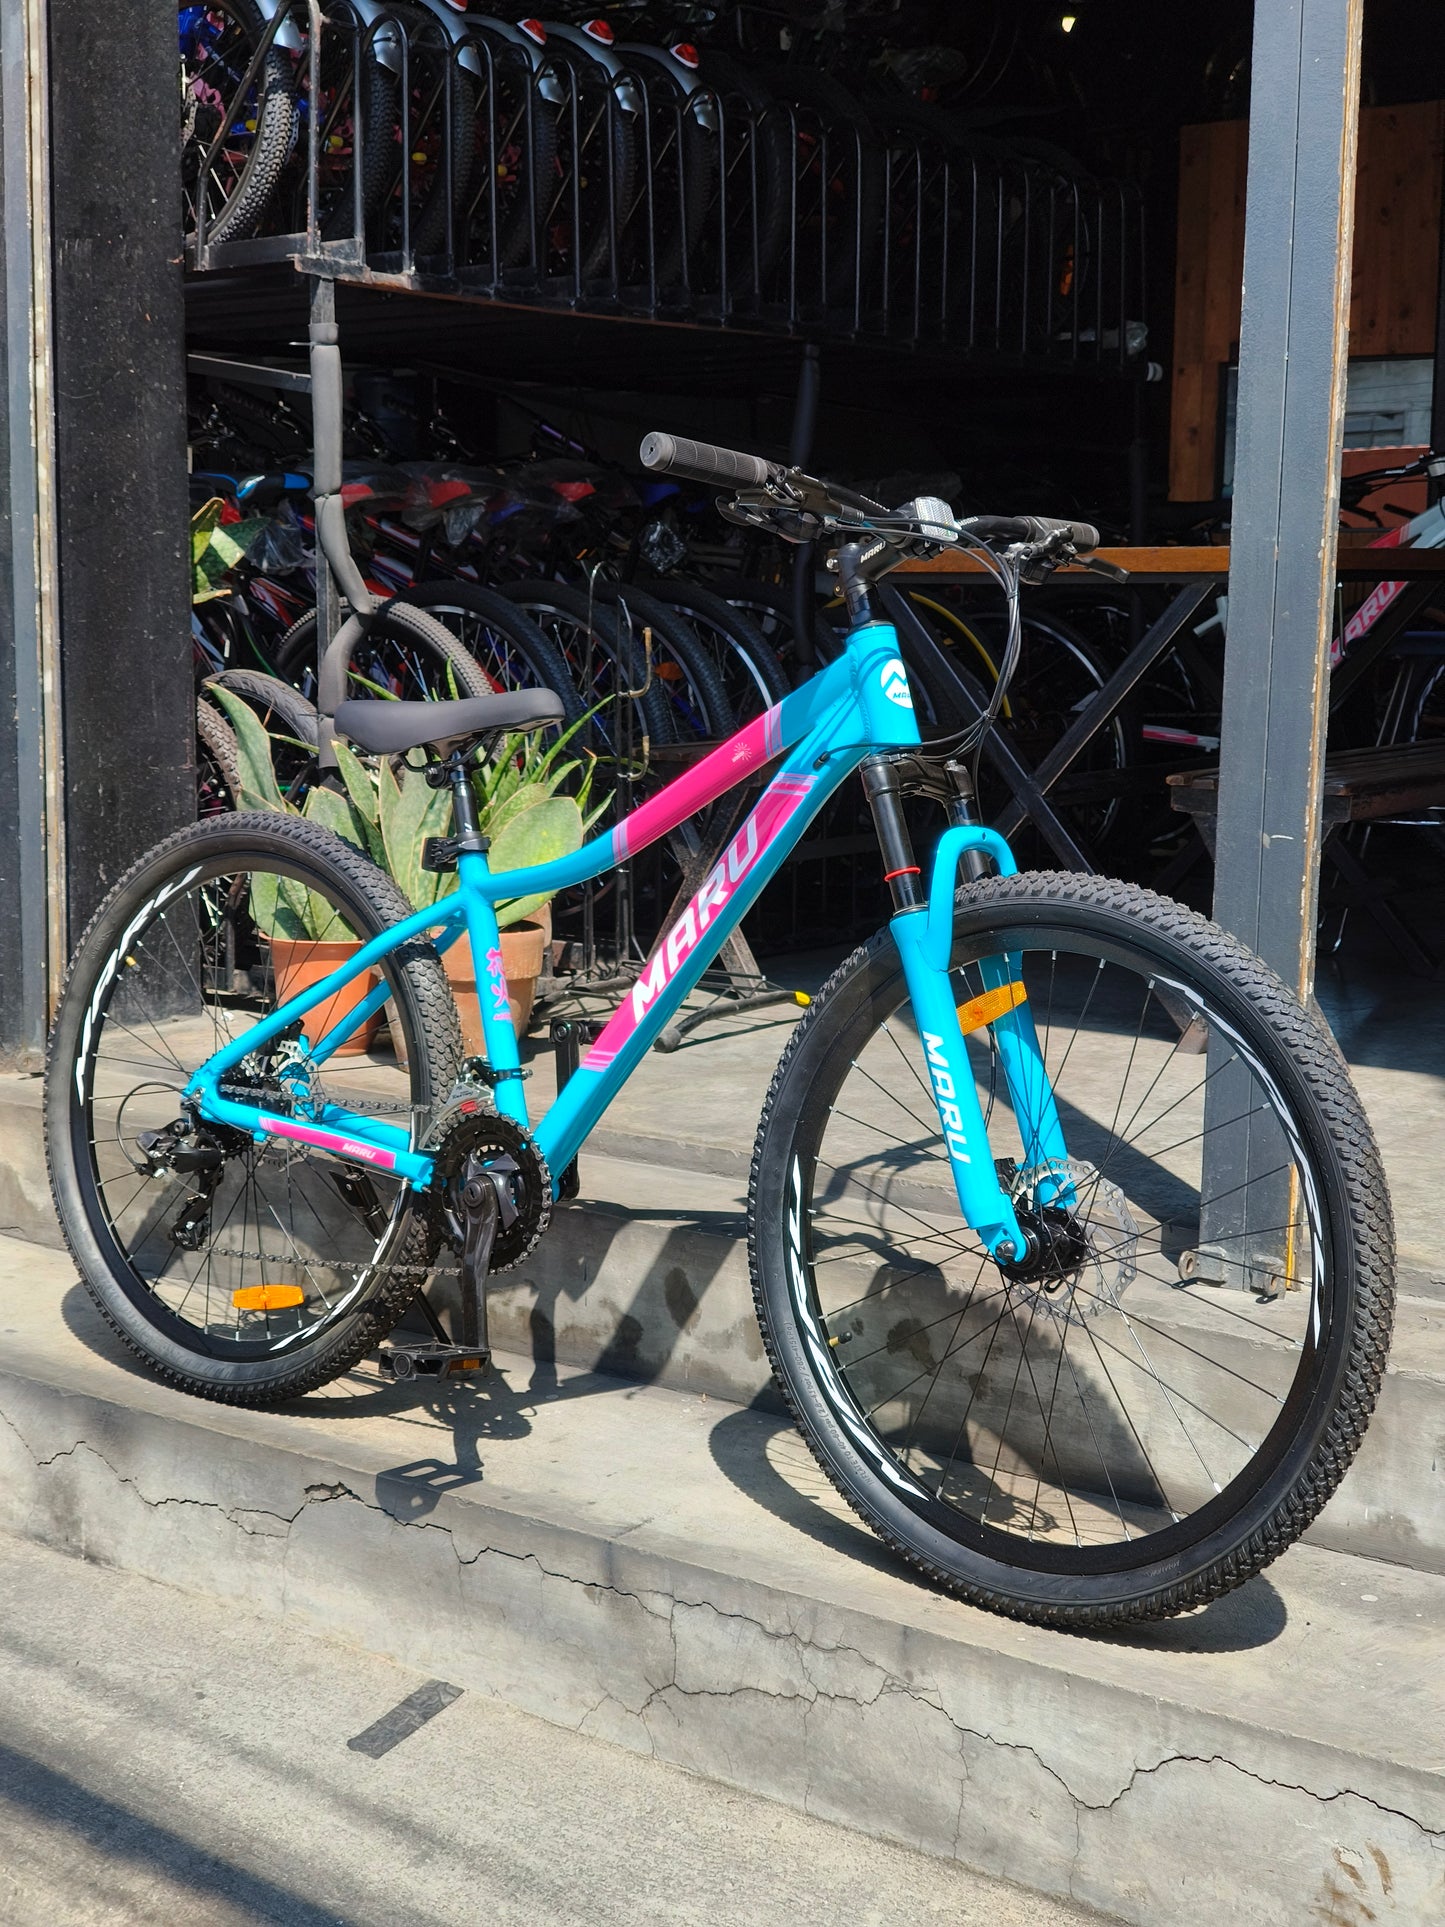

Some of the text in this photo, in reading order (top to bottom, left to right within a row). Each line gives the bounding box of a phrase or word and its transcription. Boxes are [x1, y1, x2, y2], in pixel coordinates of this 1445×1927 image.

[860, 540, 887, 564] MARU
[631, 813, 759, 1024] MARU
[921, 1030, 972, 1165] MARU
[342, 1142, 377, 1159] MARU
[842, 1449, 854, 1461] TO
[850, 1459, 875, 1486] INFLATE
